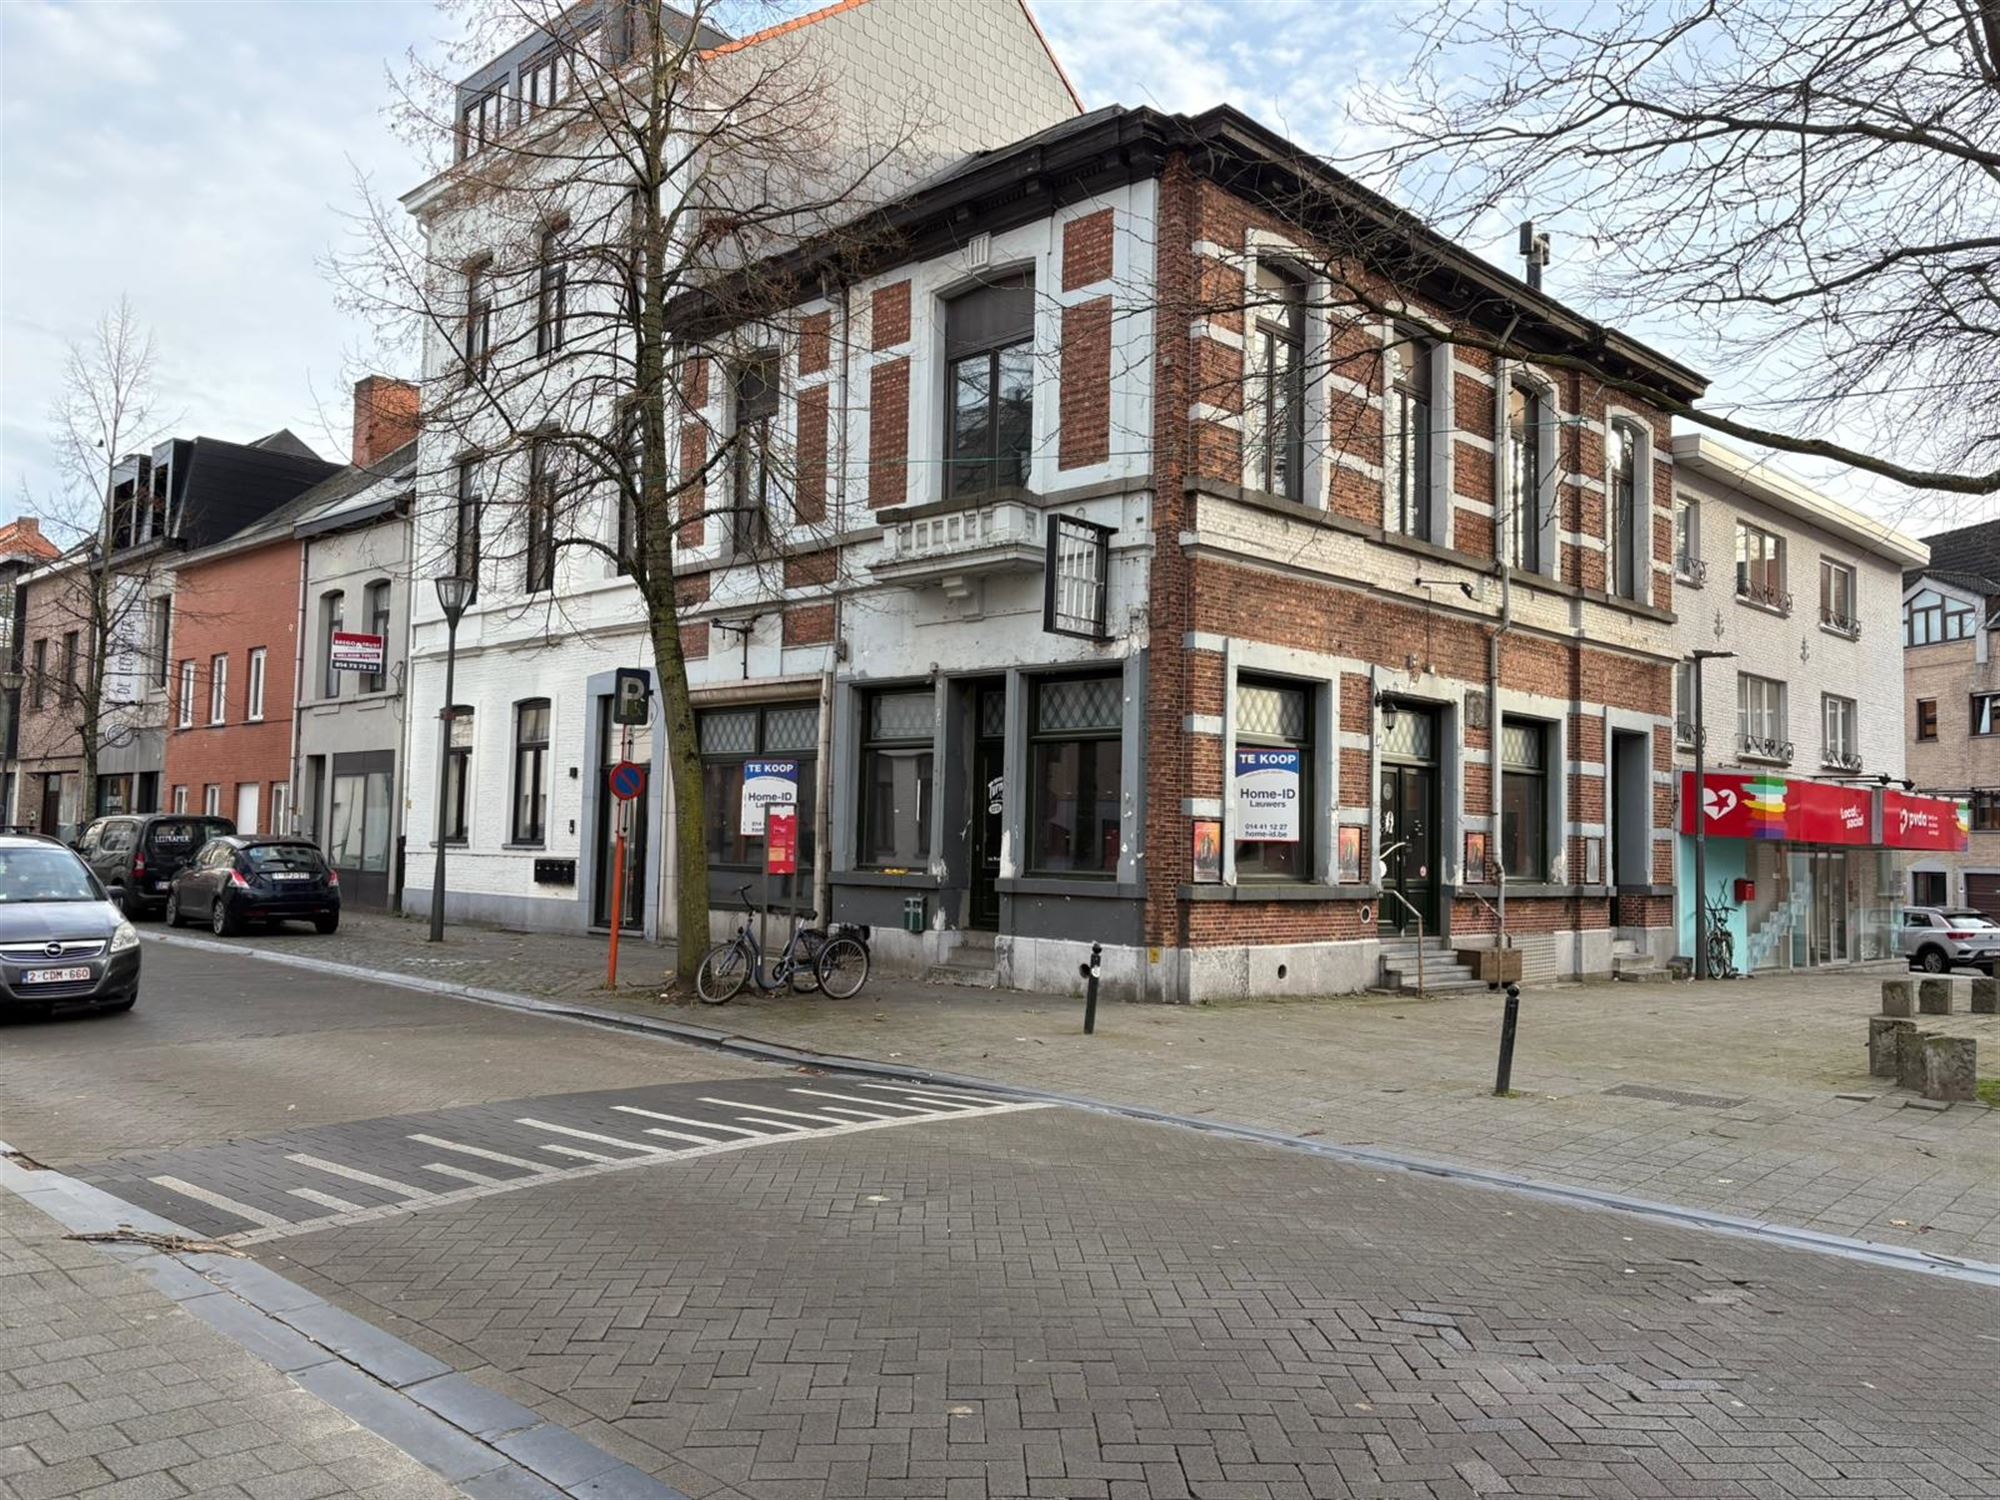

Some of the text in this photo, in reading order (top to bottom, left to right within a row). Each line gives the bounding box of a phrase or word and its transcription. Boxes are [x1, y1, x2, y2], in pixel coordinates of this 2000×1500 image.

[620, 676, 645, 716] P
[1239, 754, 1296, 764] TE KOOP
[748, 764, 794, 773] TE KOOP
[748, 792, 792, 801] Home-ID
[1240, 788, 1296, 799] Home-ID
[1249, 800, 1287, 808] Lauwers
[1908, 811, 1927, 828] pvda
